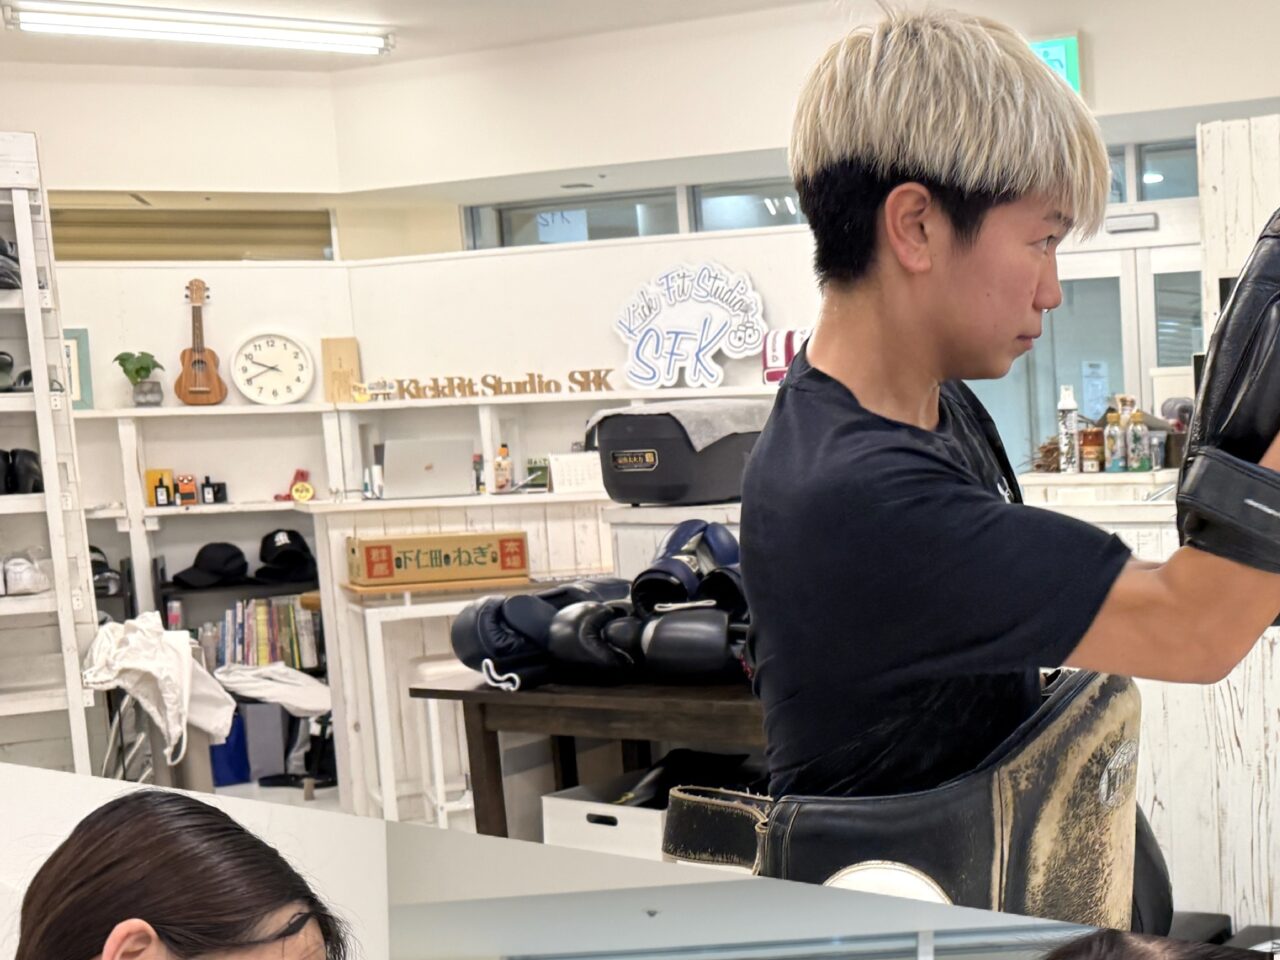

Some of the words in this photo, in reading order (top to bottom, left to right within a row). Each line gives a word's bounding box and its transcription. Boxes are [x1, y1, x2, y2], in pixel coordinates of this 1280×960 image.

[618, 290, 659, 337] Kick
[658, 270, 693, 302] Fit
[693, 266, 748, 314] Studio
[628, 317, 730, 382] SFK
[480, 373, 563, 397] Studio
